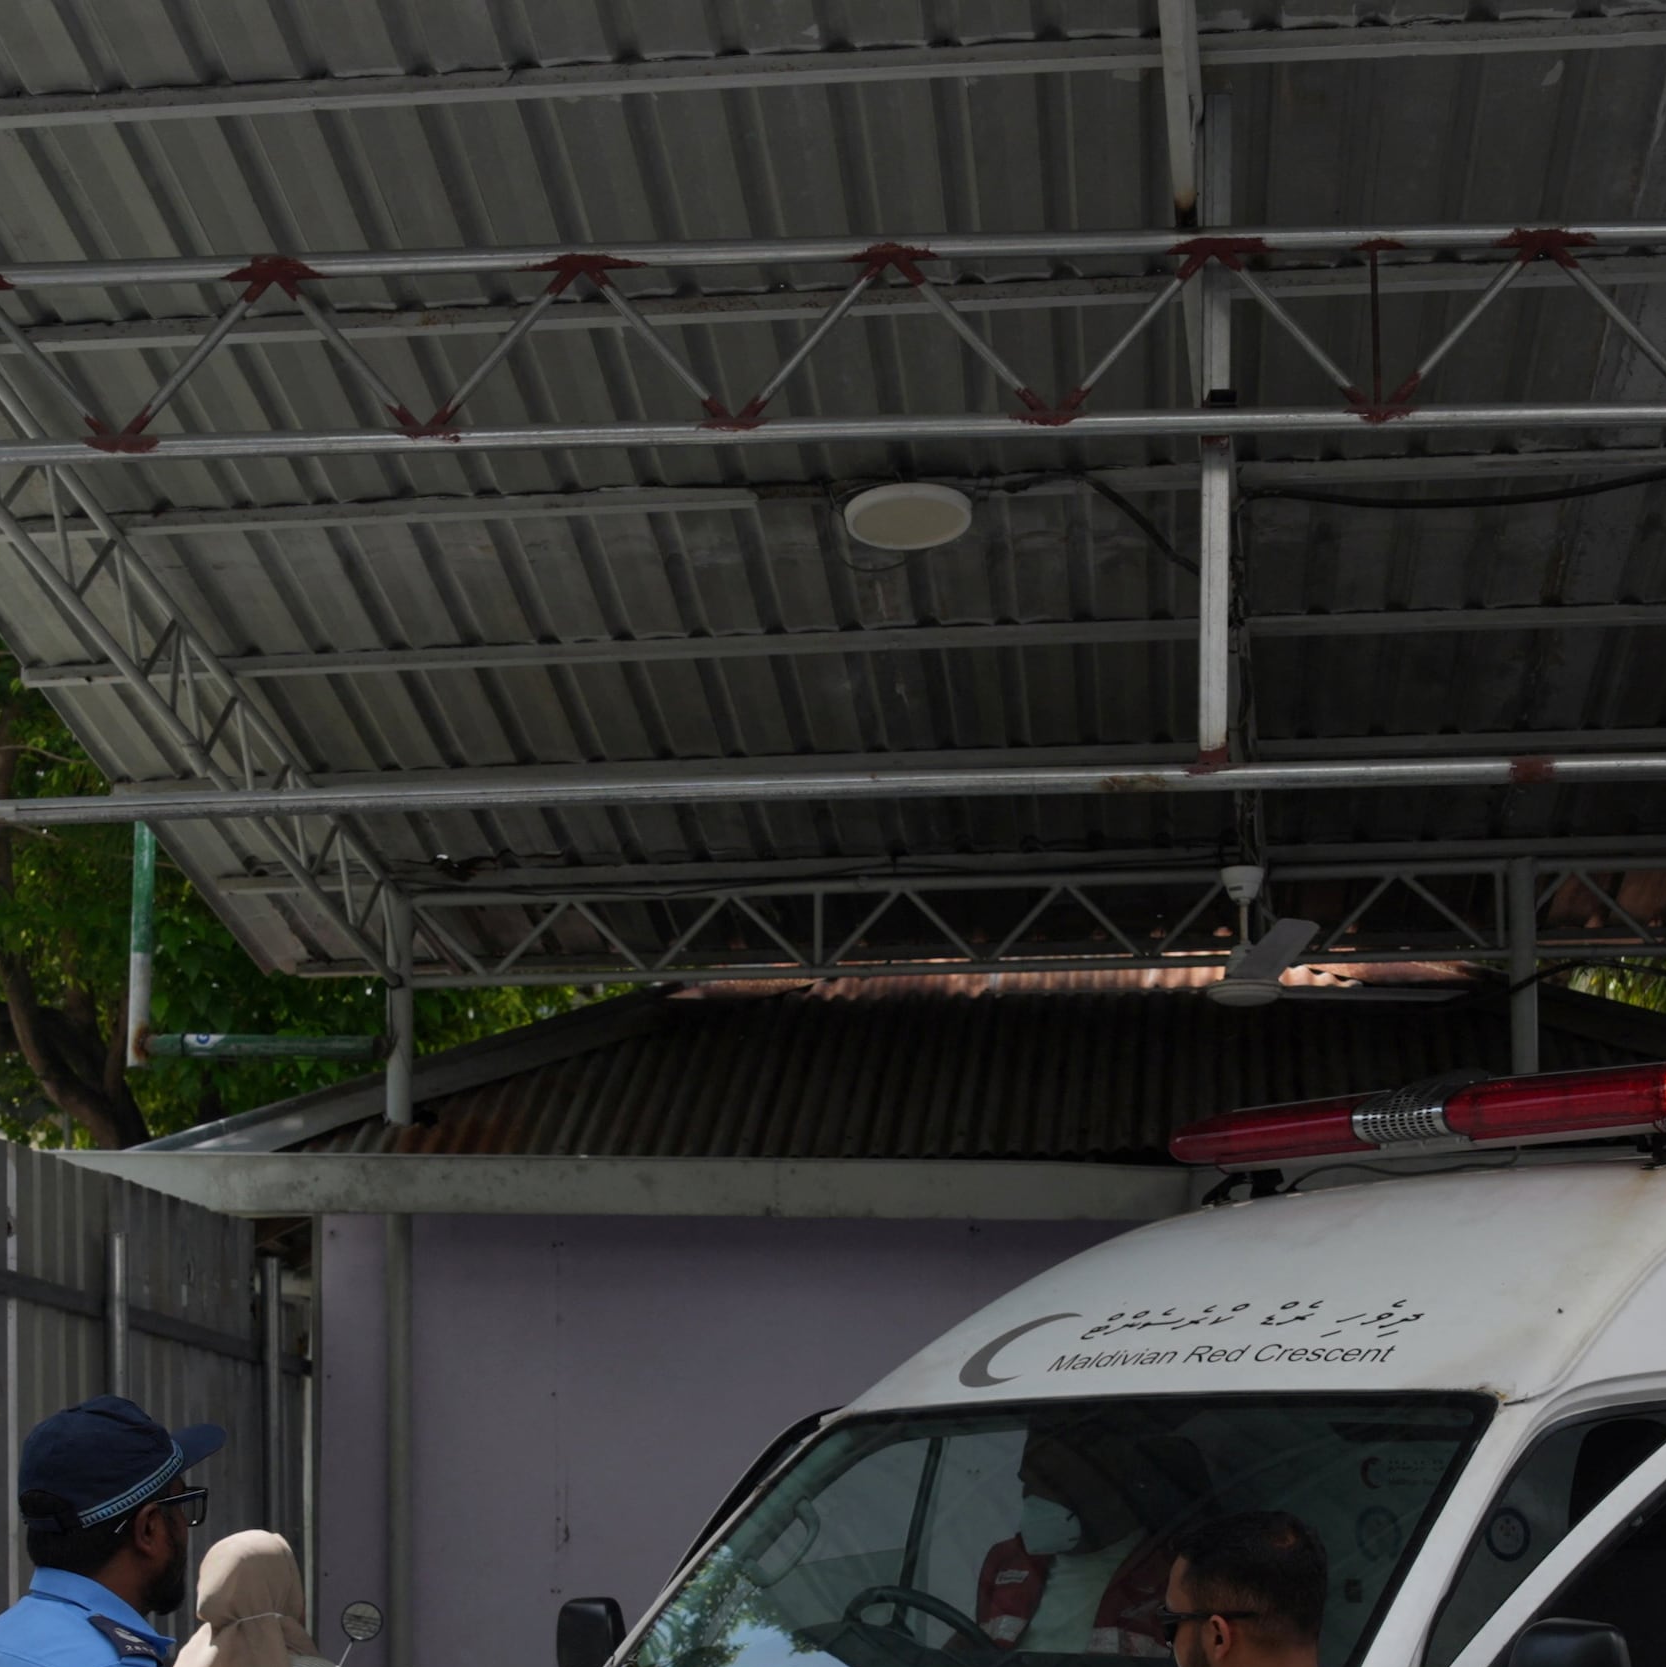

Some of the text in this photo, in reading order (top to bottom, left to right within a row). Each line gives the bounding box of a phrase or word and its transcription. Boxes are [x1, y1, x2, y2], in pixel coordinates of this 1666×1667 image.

[1047, 1343, 1396, 1373] Maldivian Red Crescent
